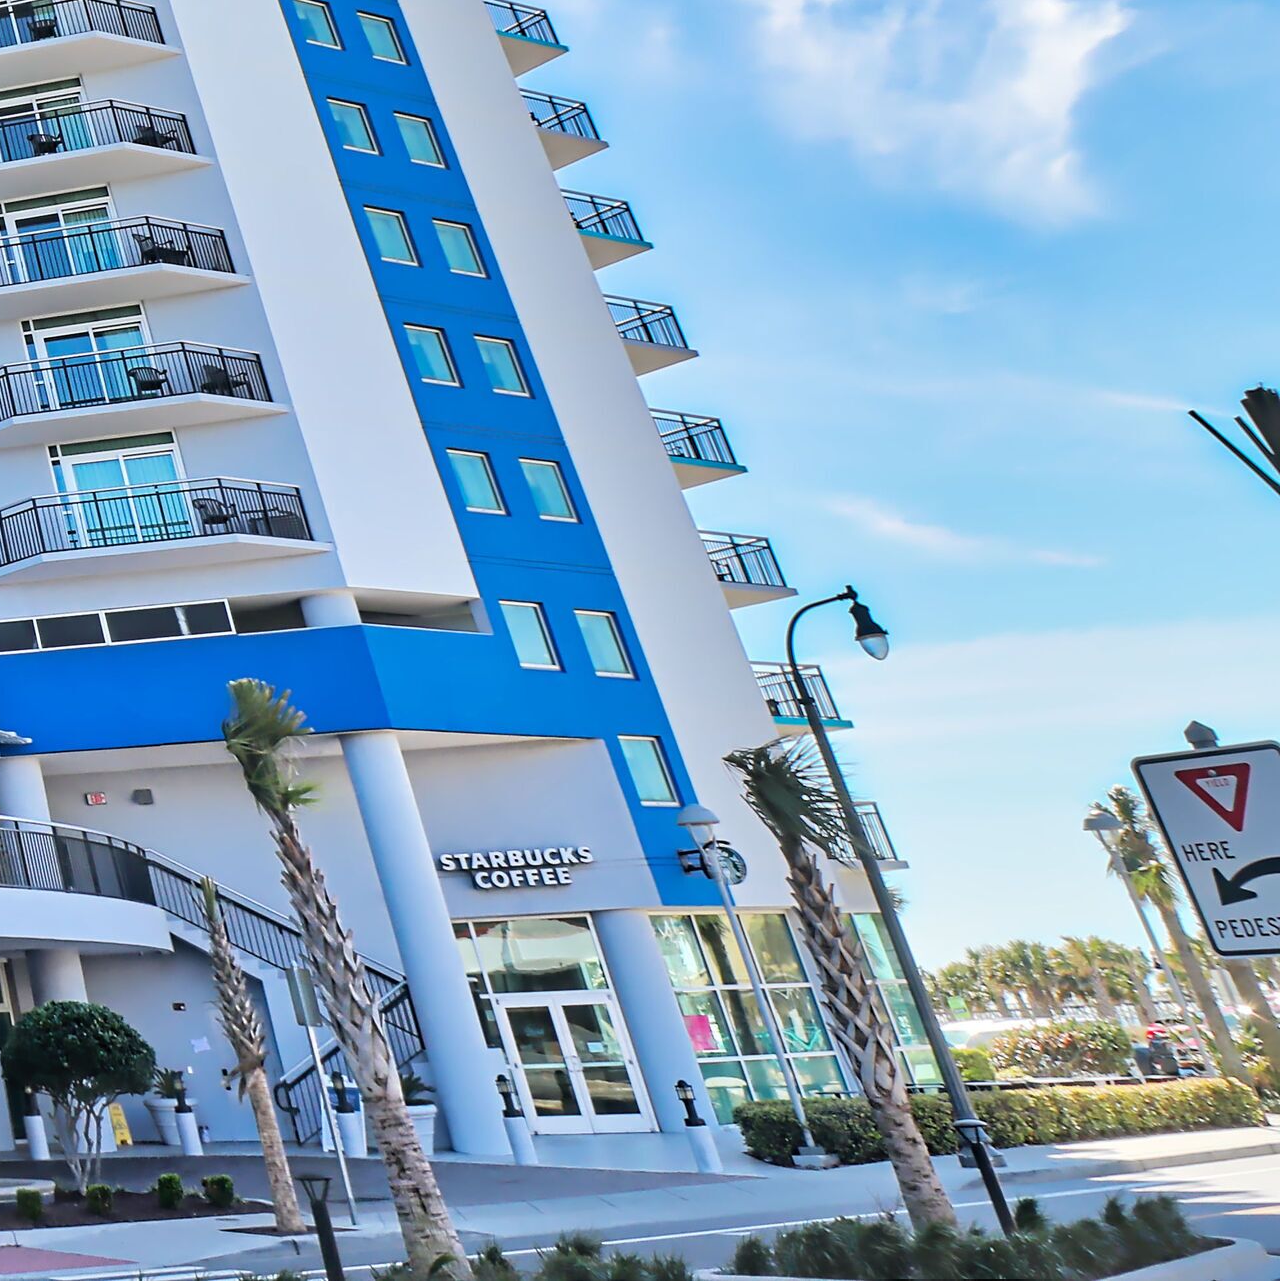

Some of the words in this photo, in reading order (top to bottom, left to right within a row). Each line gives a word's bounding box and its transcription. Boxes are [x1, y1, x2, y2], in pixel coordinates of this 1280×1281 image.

[1205, 777, 1230, 788] YIELD
[439, 846, 594, 871] STARBUCKS
[1182, 840, 1235, 862] HERE
[474, 867, 573, 889] COFFEE
[1214, 916, 1280, 938] PEDES
